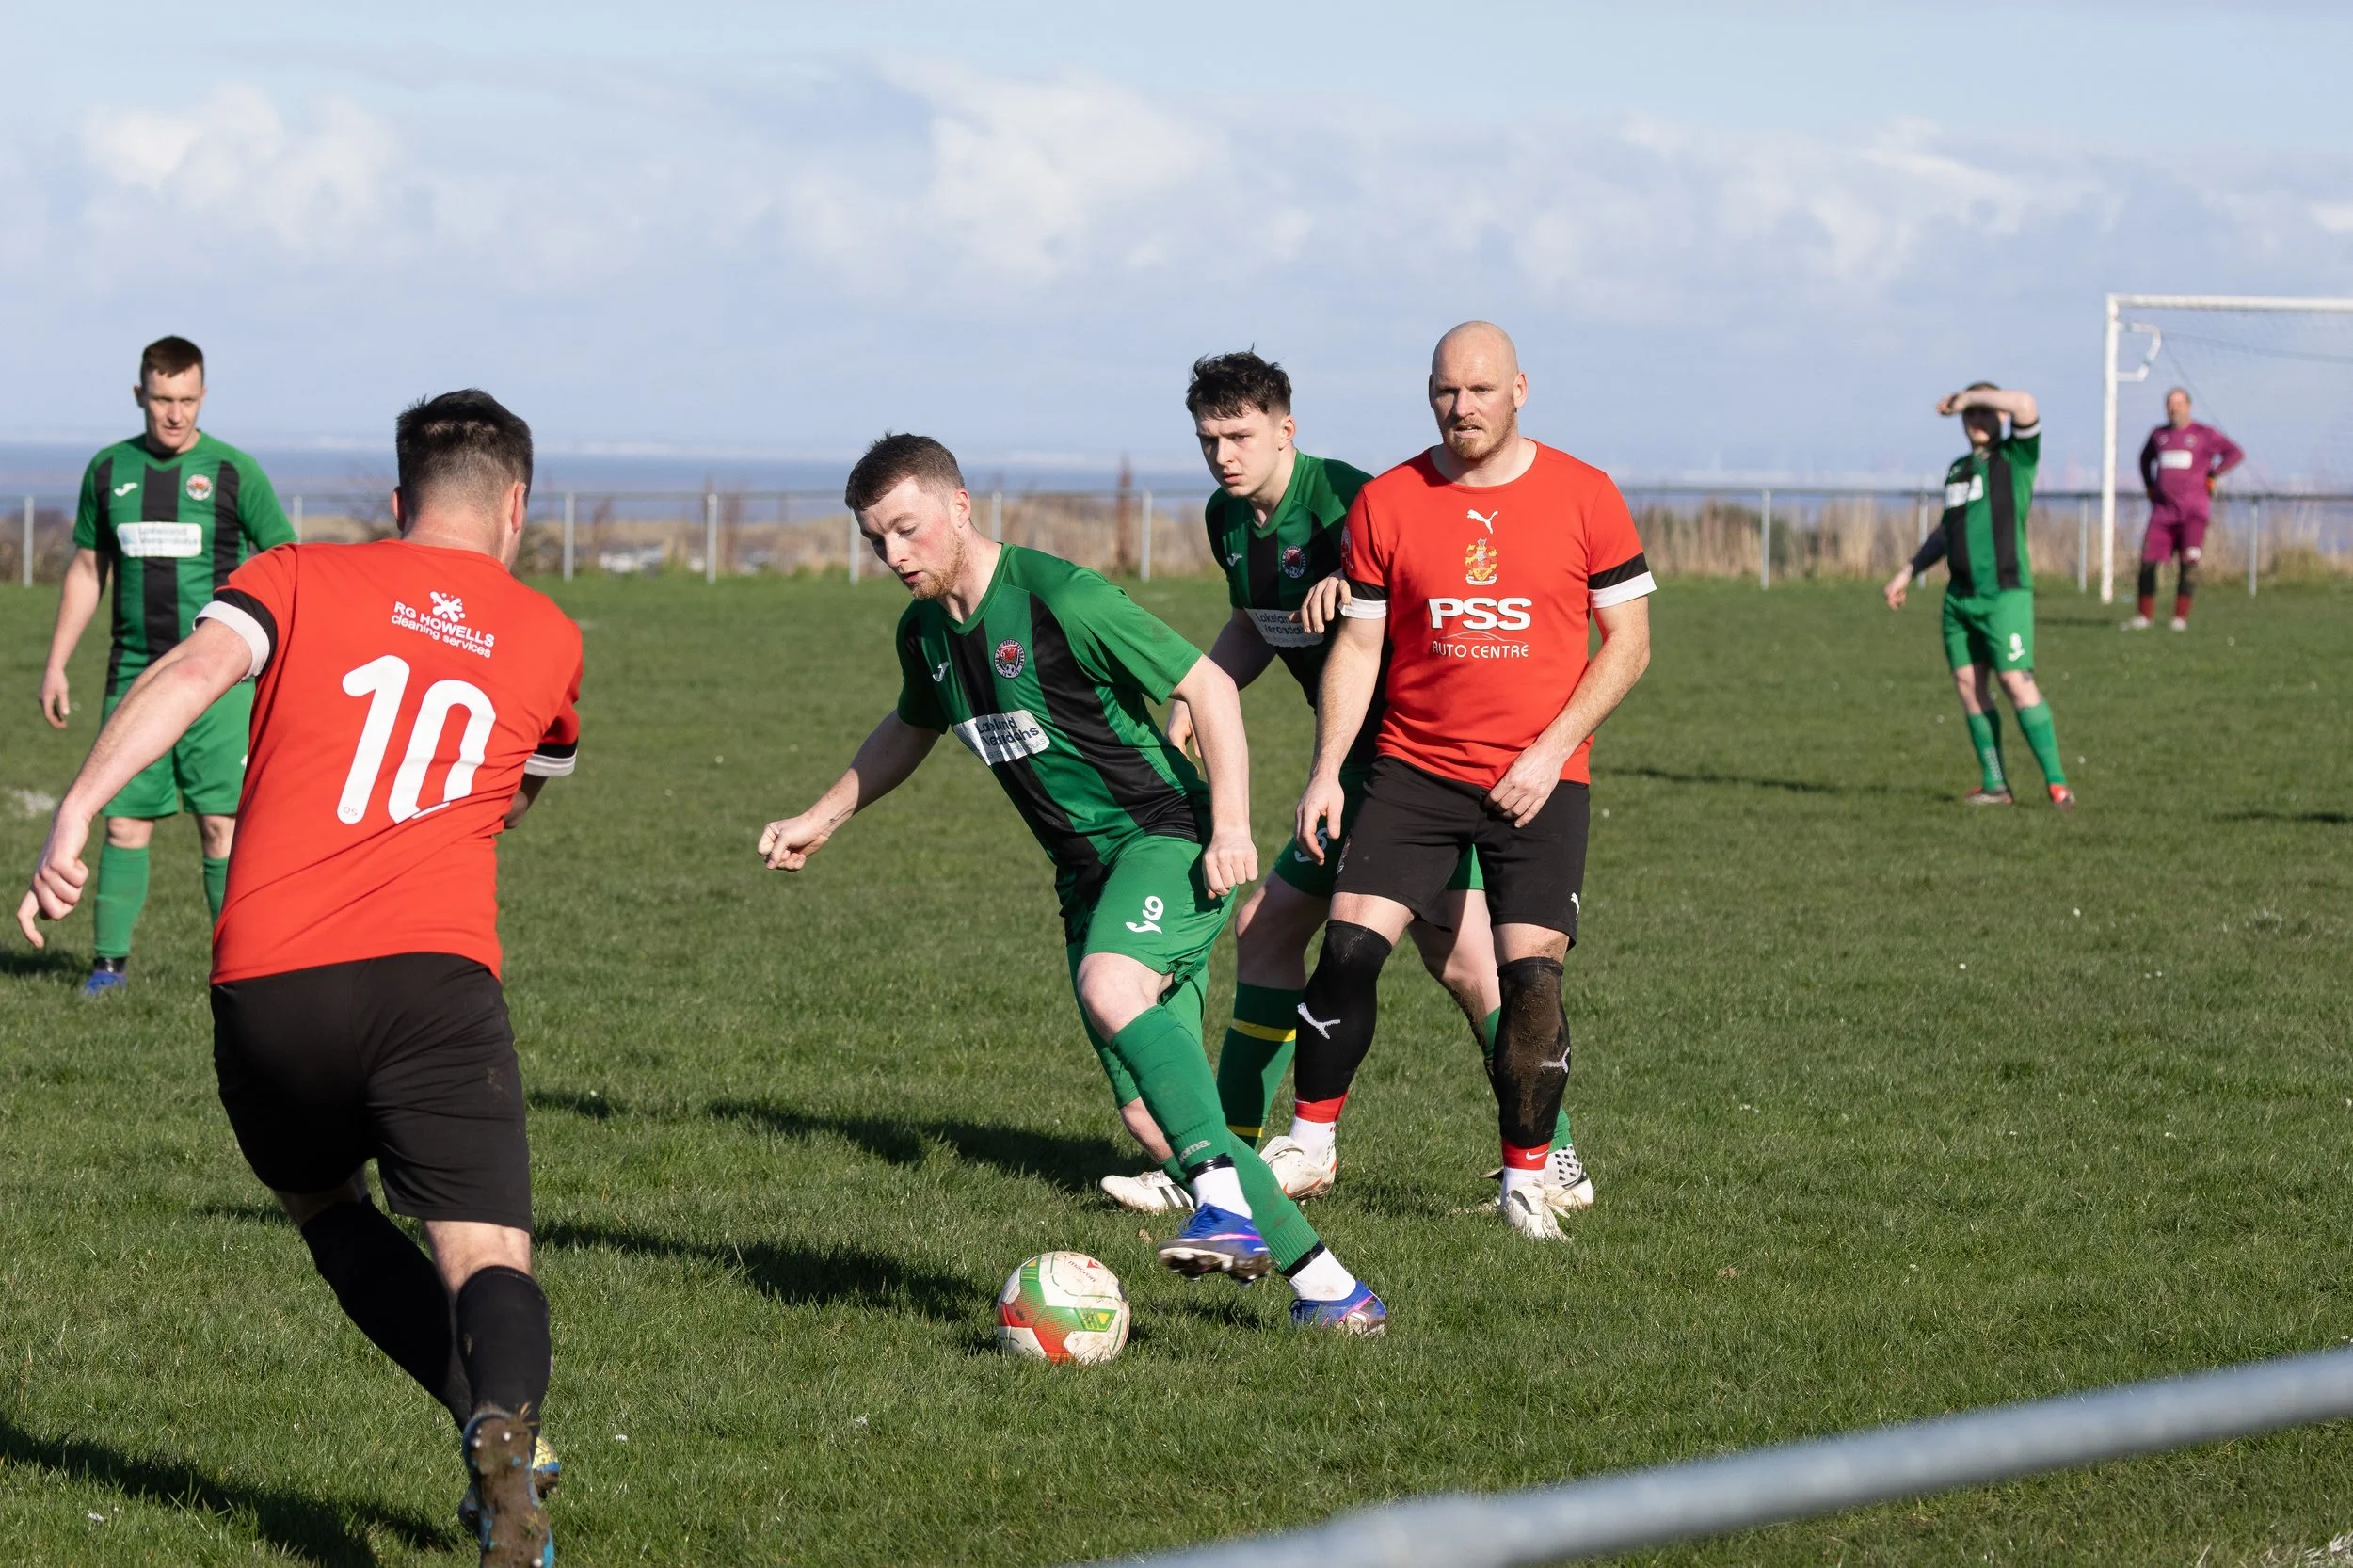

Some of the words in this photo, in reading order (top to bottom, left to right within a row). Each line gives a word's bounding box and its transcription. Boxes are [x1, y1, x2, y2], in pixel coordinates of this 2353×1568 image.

[393, 601, 416, 618] RG
[420, 613, 495, 648] HOWELLS
[1428, 597, 1532, 631] PSS
[391, 614, 440, 640] cleaning
[442, 633, 491, 658] services
[1433, 641, 1466, 658] AUTO
[1471, 644, 1529, 658] CENTRE
[337, 655, 496, 824] 10
[1142, 895, 1164, 920] 9
